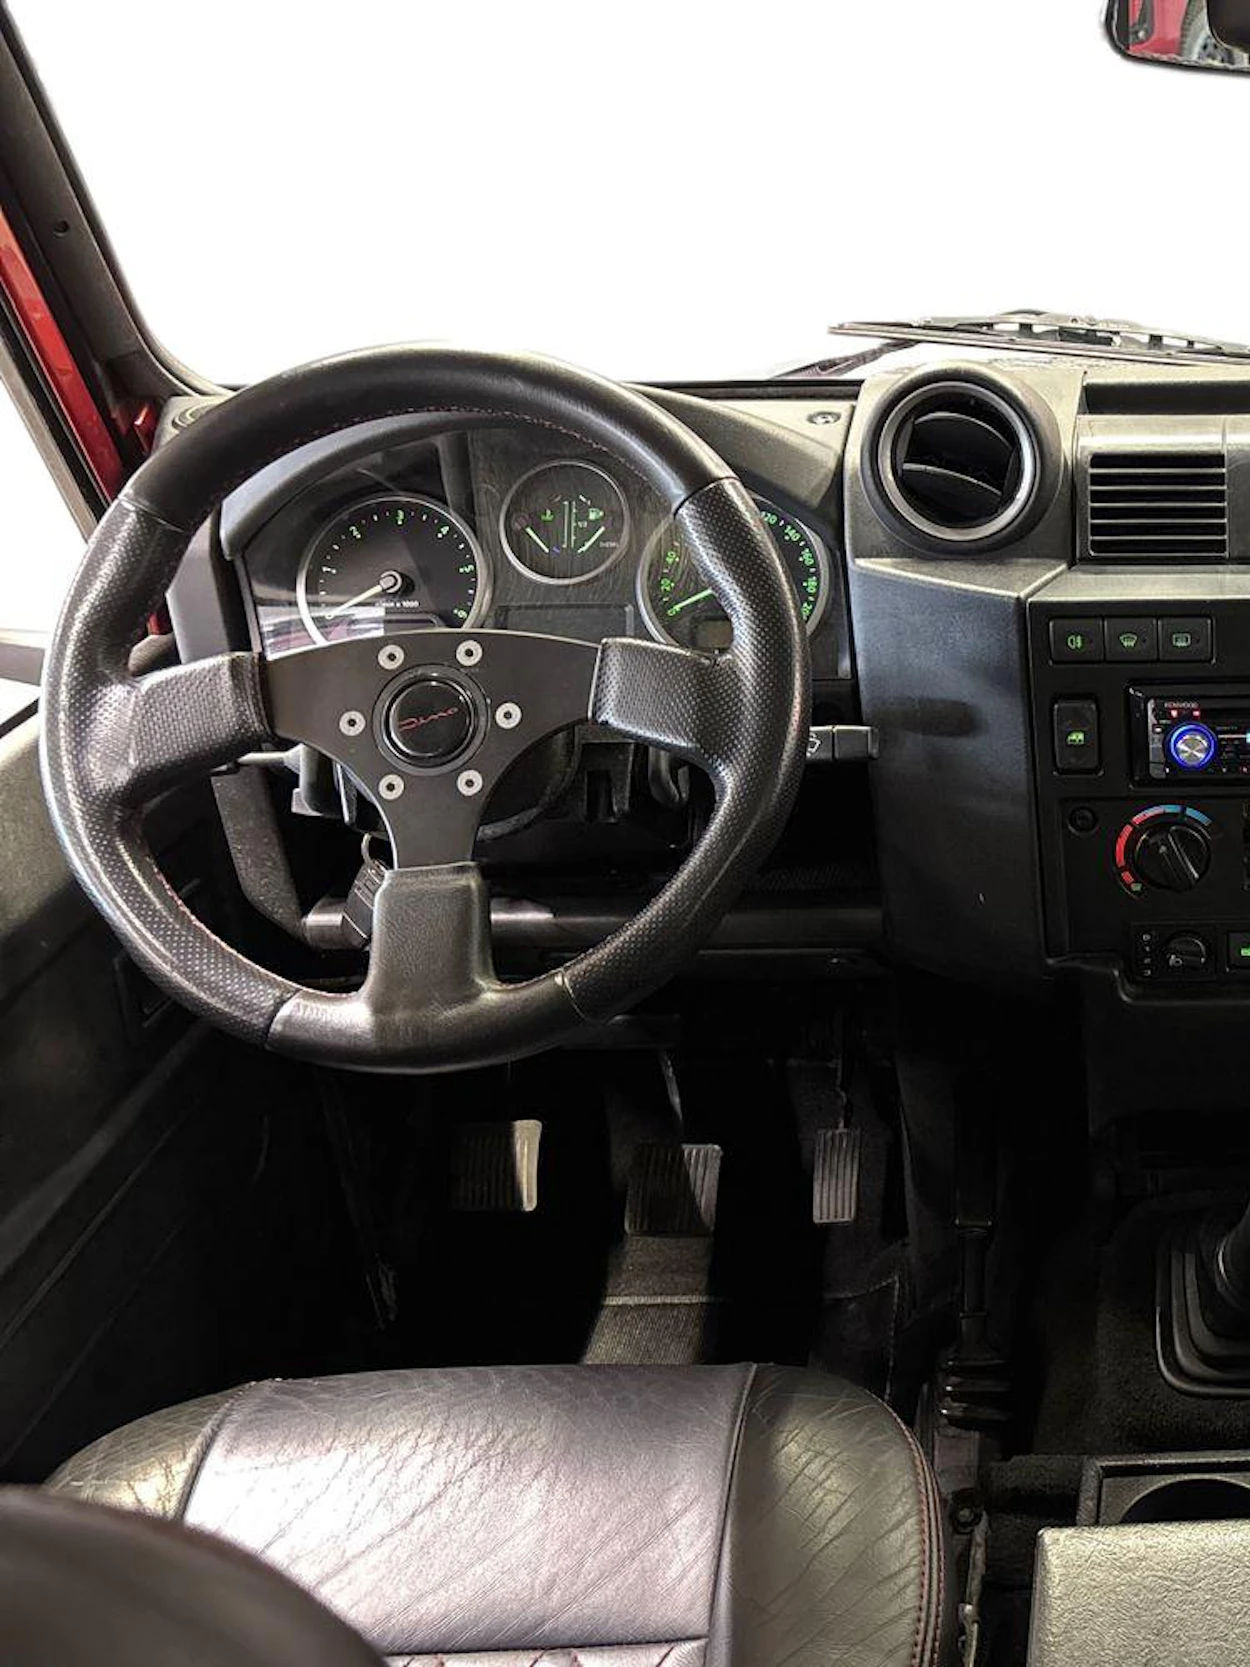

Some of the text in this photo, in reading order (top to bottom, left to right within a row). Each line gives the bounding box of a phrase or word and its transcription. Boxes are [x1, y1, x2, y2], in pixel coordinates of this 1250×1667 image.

[349, 526, 359, 536] 2
[441, 525, 450, 535] 4
[784, 525, 801, 542] 140
[665, 551, 677, 565] 40
[800, 547, 815, 567] 160
[464, 564, 475, 574] 5
[807, 576, 818, 594] 180
[401, 600, 420, 608] 1000
